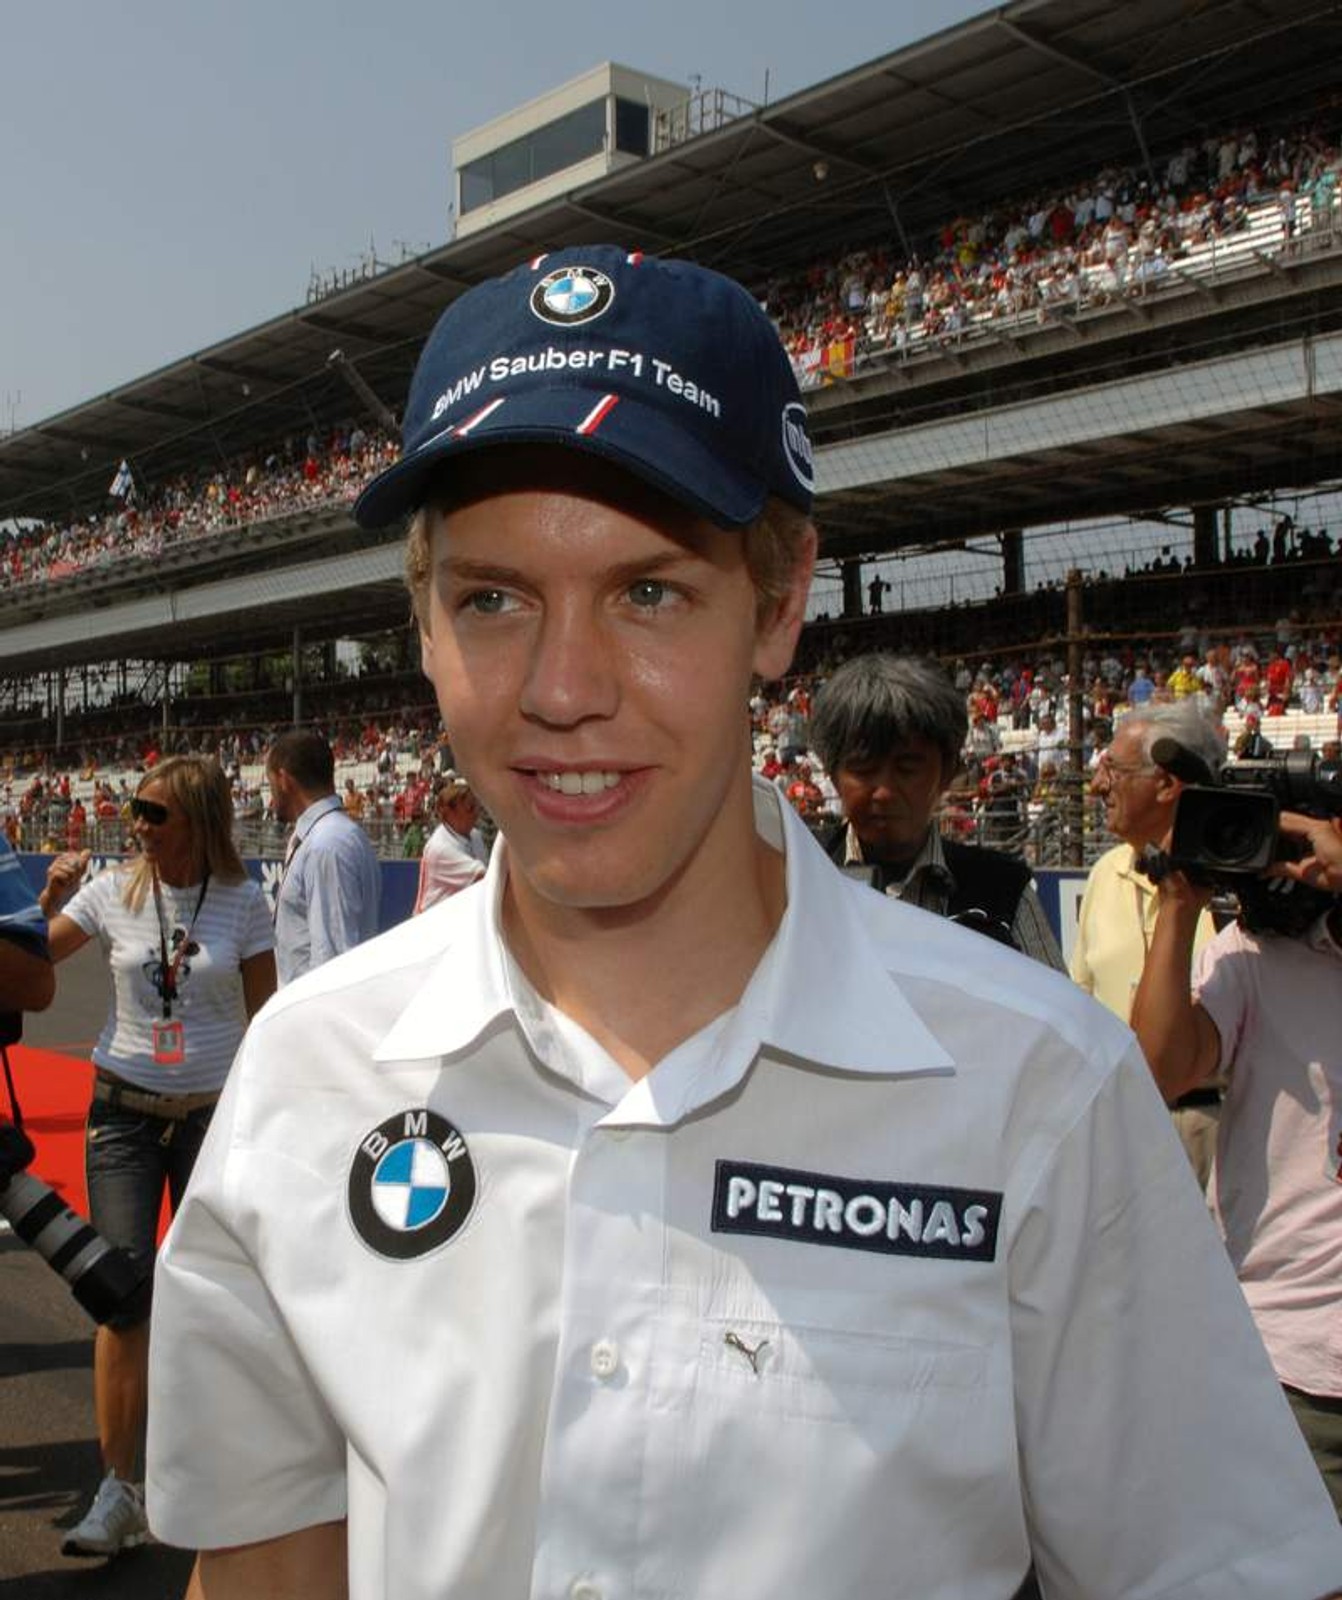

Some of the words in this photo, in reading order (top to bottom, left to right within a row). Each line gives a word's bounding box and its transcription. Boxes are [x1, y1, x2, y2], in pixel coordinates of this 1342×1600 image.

[430, 366, 486, 421] BMW
[489, 347, 604, 381] Sauber
[608, 349, 644, 377] F1
[651, 359, 721, 418] Team
[362, 1111, 466, 1162] BMW
[726, 1176, 988, 1246] PETRONAS
